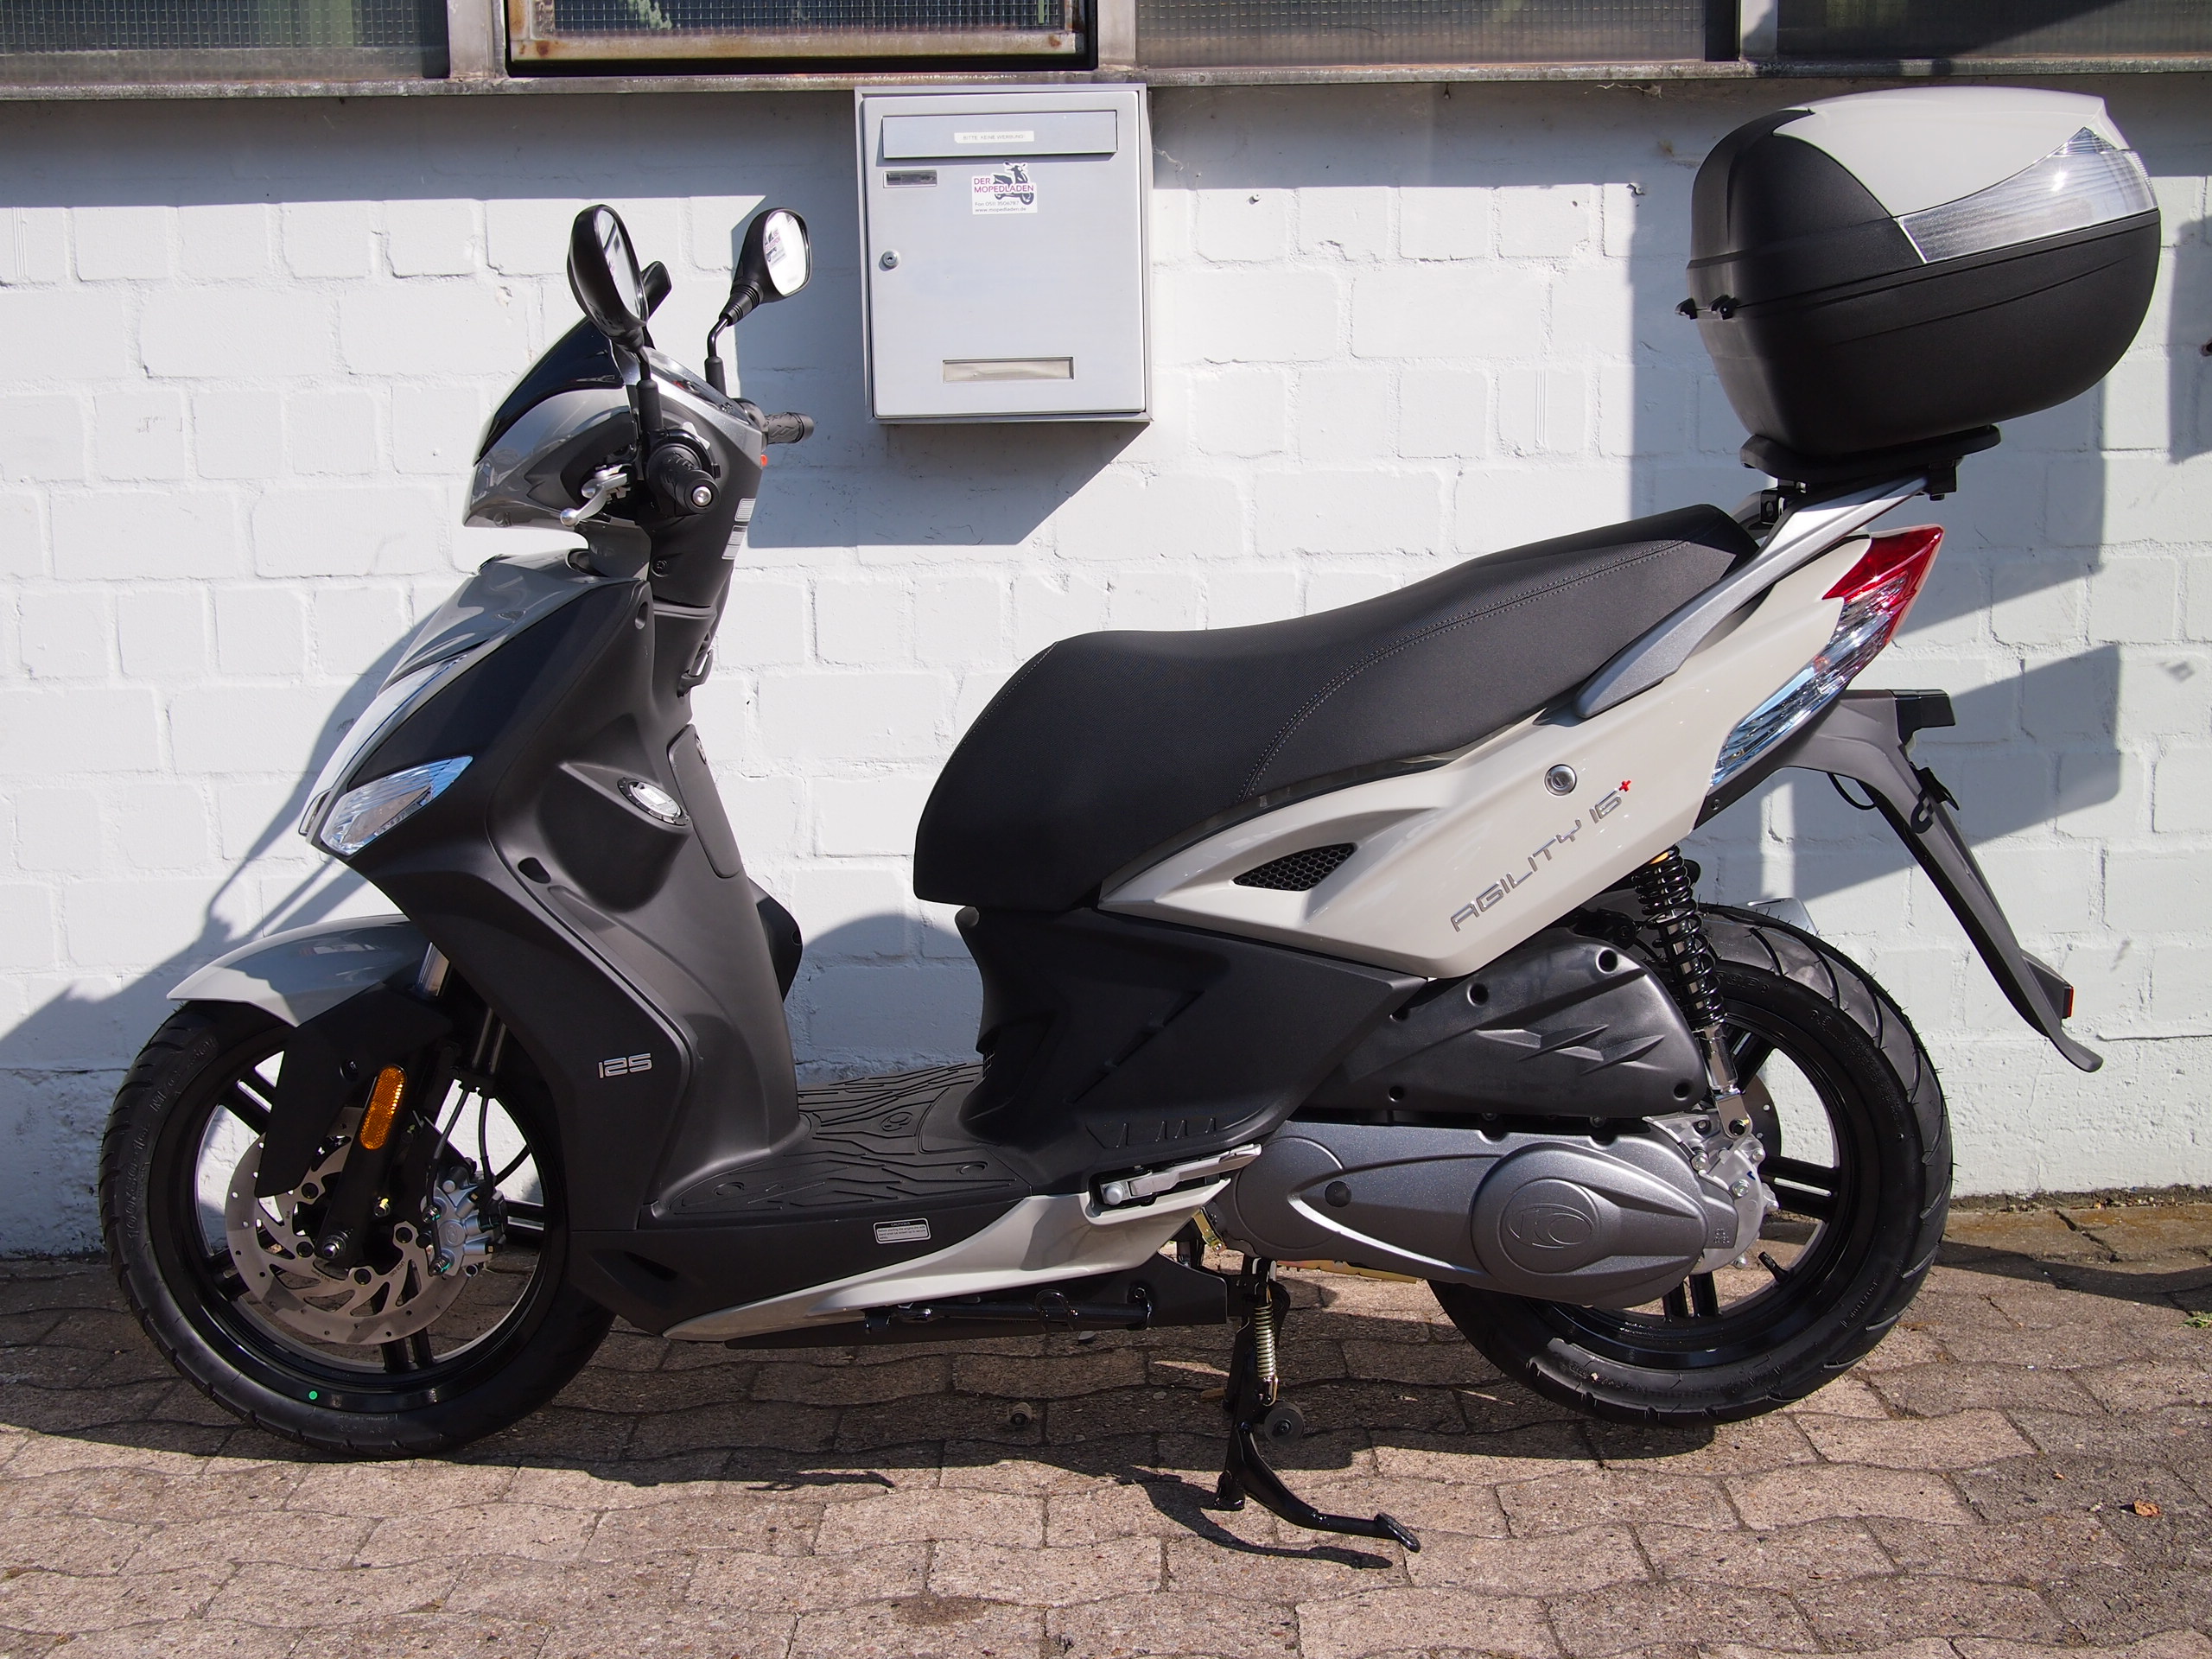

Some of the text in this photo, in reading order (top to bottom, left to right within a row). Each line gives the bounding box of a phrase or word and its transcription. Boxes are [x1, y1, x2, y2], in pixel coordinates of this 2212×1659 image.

[974, 184, 1034, 194] MOPEDLADEN
[1450, 817, 1582, 932] AGILITY
[598, 1052, 652, 1078] 125
